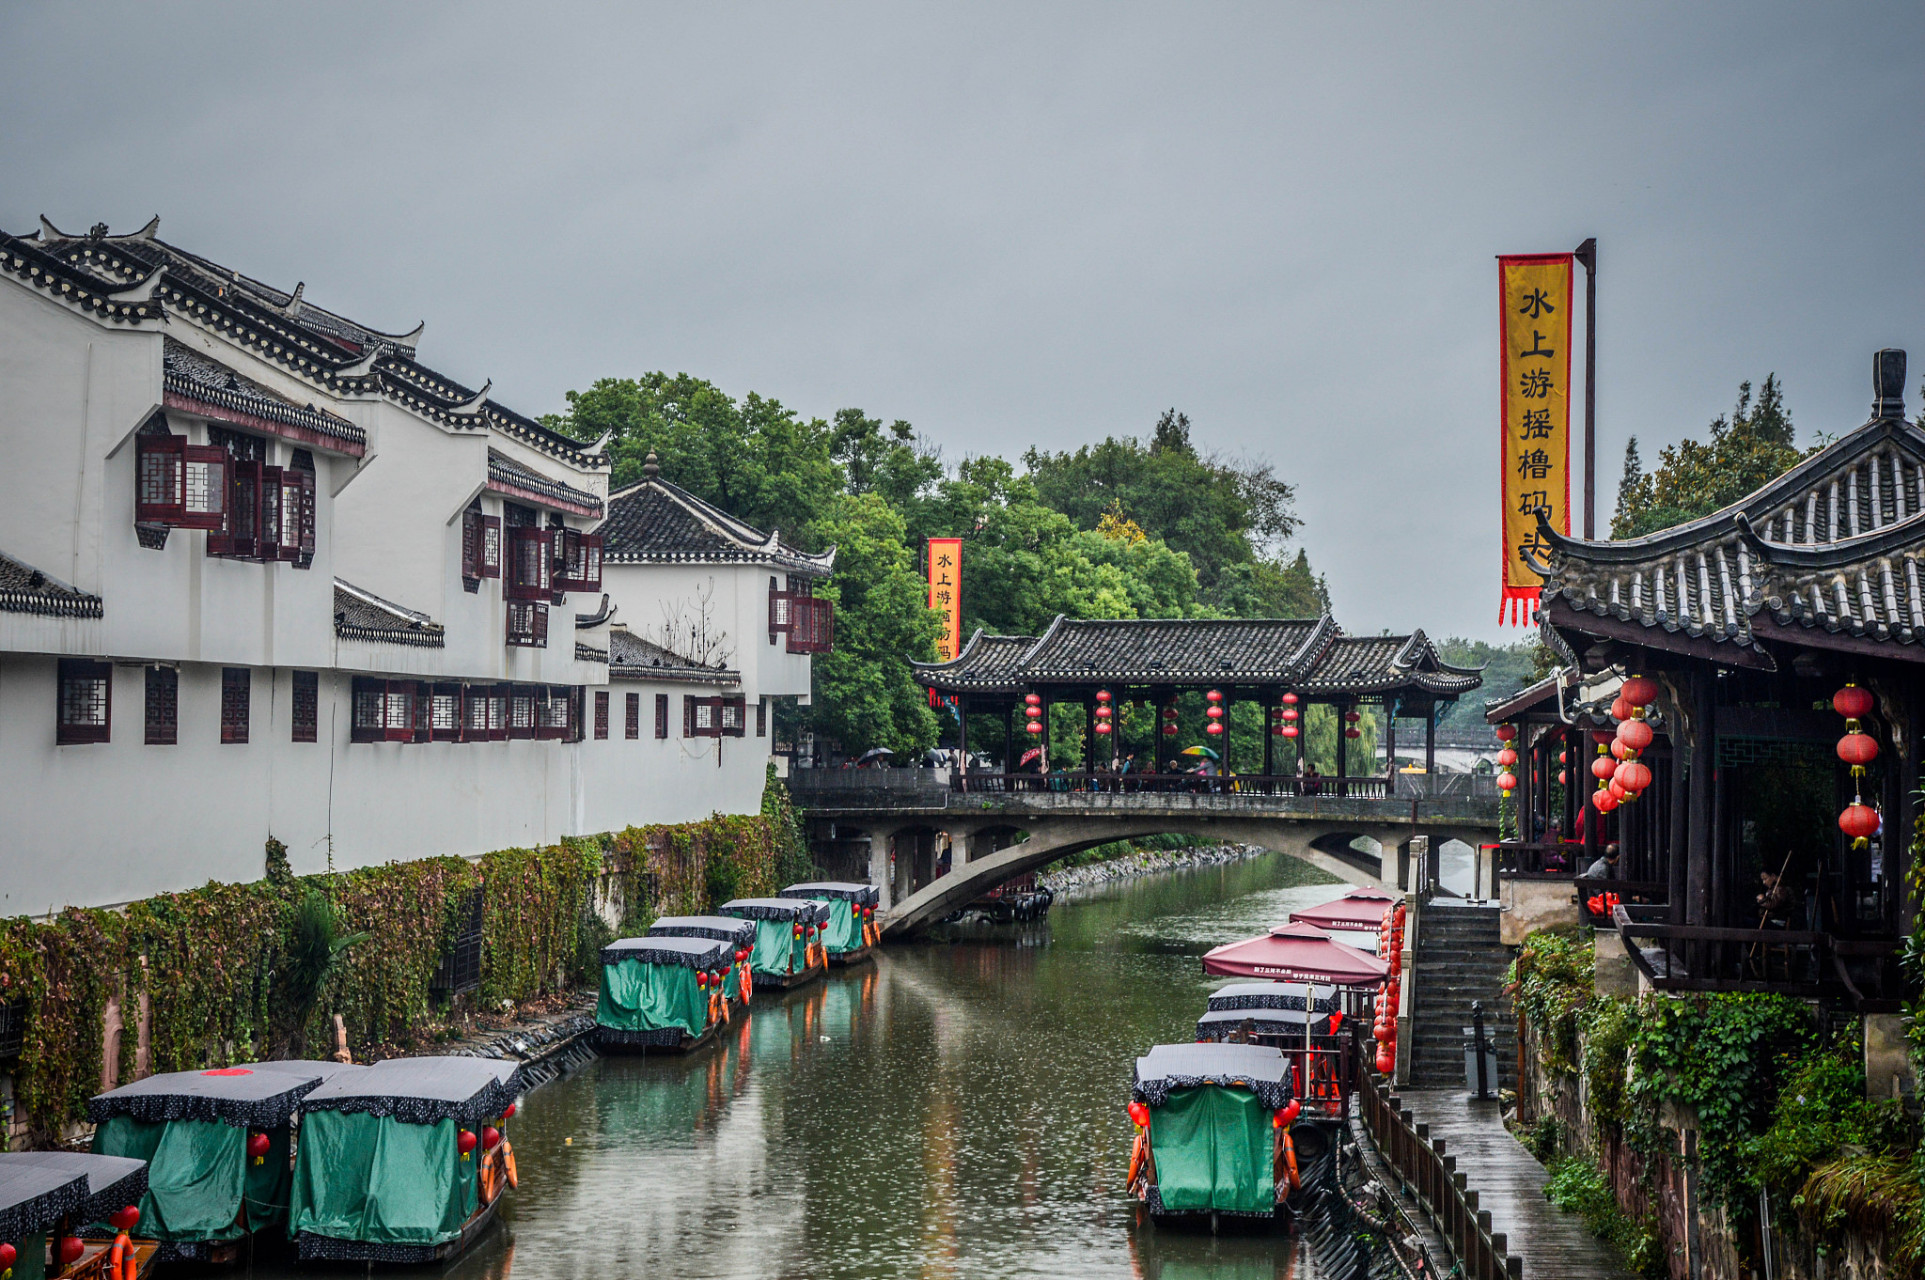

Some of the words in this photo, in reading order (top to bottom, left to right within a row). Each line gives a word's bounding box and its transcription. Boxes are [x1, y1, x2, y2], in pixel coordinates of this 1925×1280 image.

[1519, 287, 1555, 561] 水上游摇橹码头
